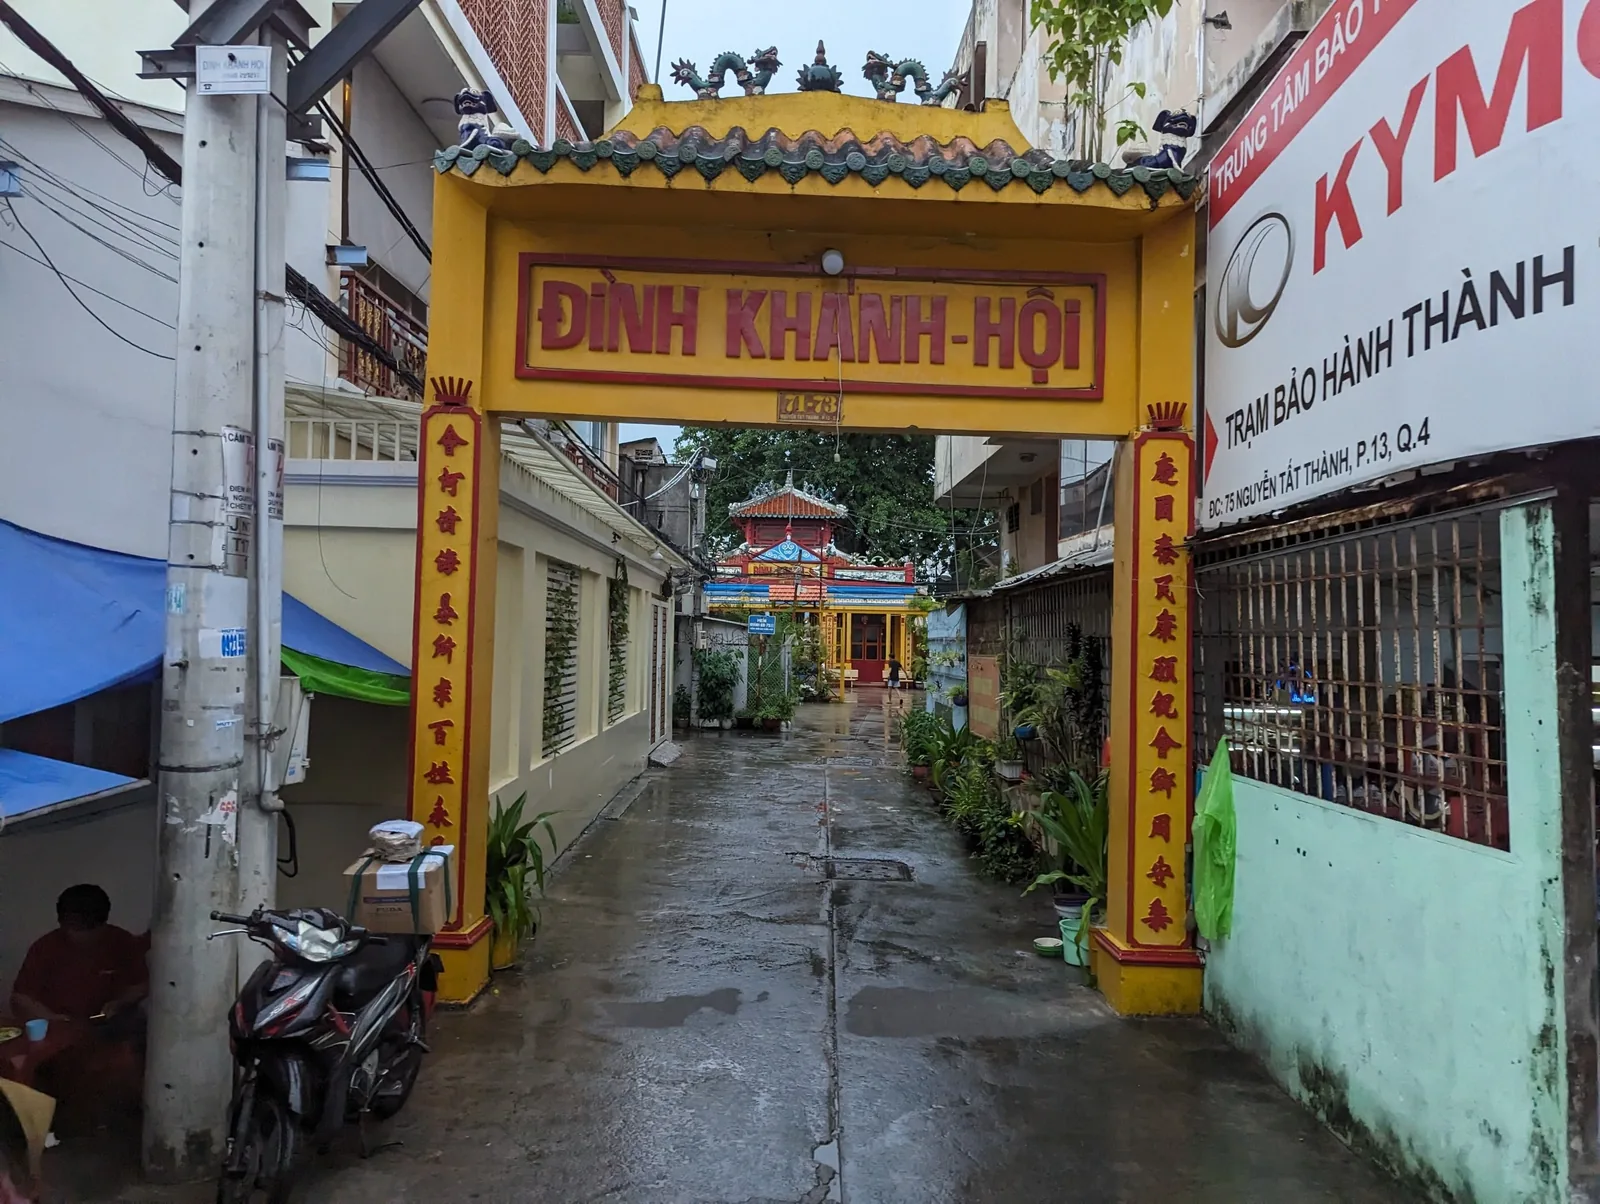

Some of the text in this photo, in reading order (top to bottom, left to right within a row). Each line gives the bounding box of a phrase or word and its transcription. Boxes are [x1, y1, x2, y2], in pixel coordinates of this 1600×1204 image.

[1215, 0, 1364, 199] TRUNG TÂM BẢO
[784, 394, 837, 413] 71-73
[1225, 245, 1575, 449] TRẠM BẢO HÀNH THÀNH
[1209, 416, 1431, 519] ĐC: 75 NGUYỄN TẤT THÀNH, P.13, Q.4
